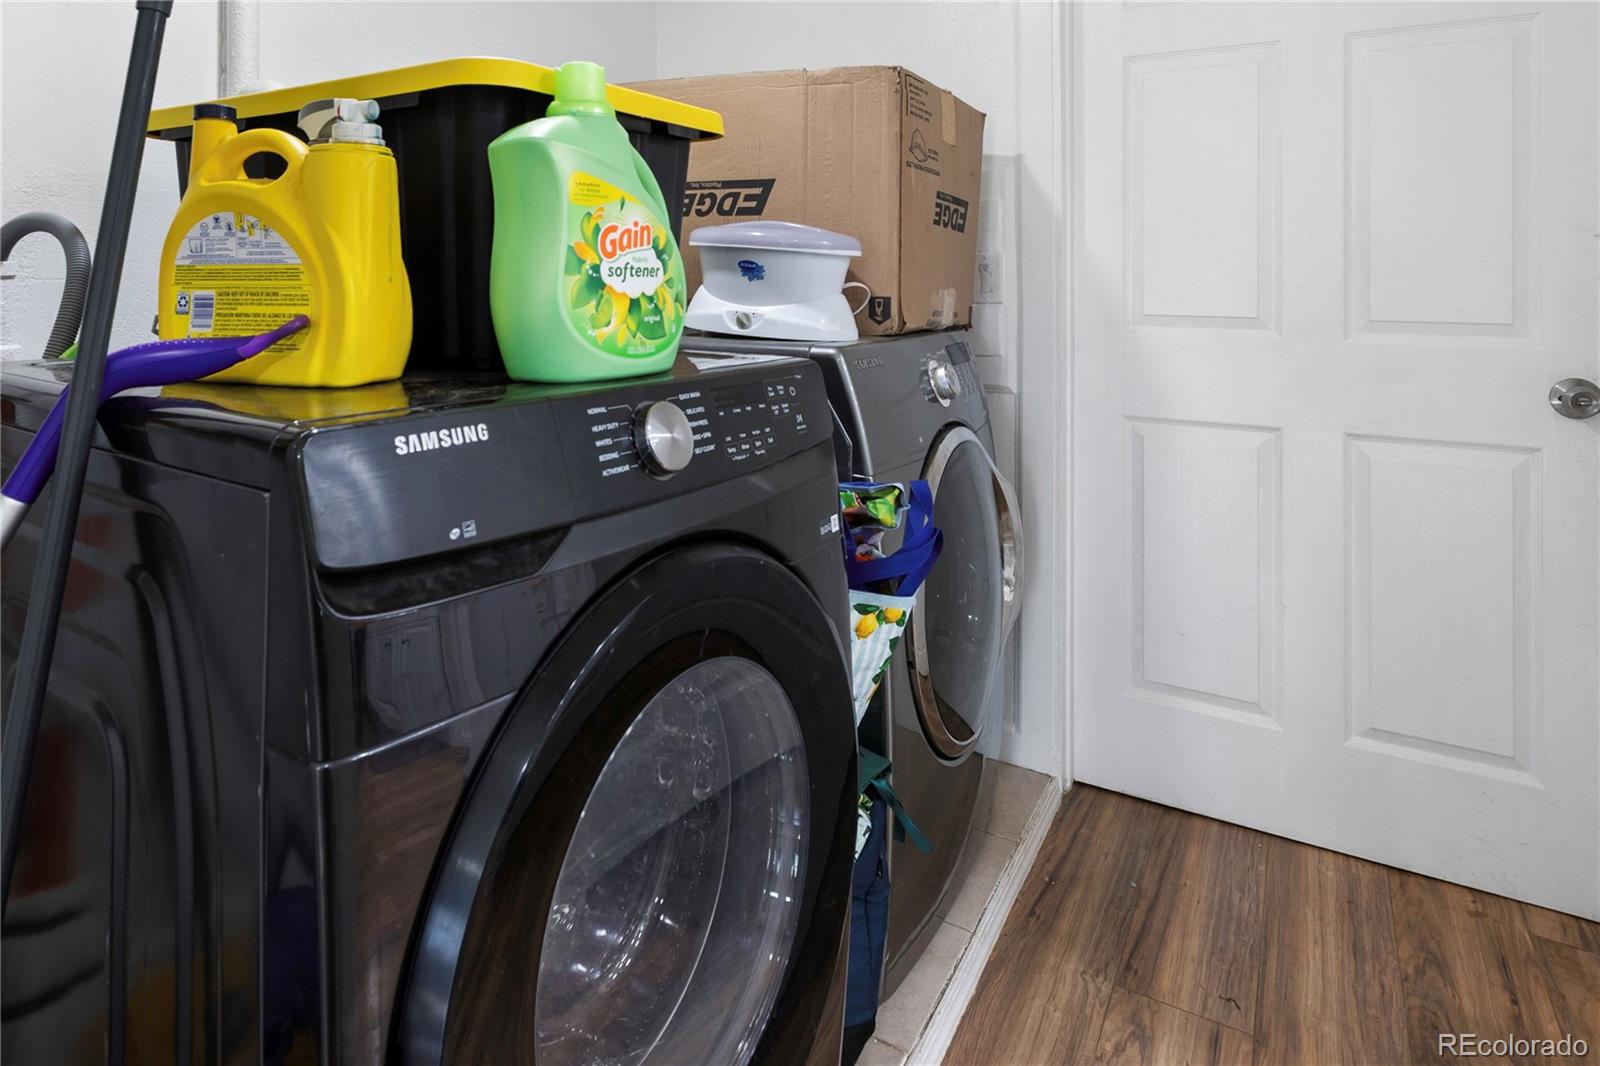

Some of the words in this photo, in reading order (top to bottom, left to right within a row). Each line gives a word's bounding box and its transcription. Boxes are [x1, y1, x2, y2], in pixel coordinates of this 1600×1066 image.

[933, 191, 968, 233] EDGE
[600, 220, 651, 259] Gain
[607, 262, 660, 283] softener
[394, 423, 489, 455] SAMSUNG
